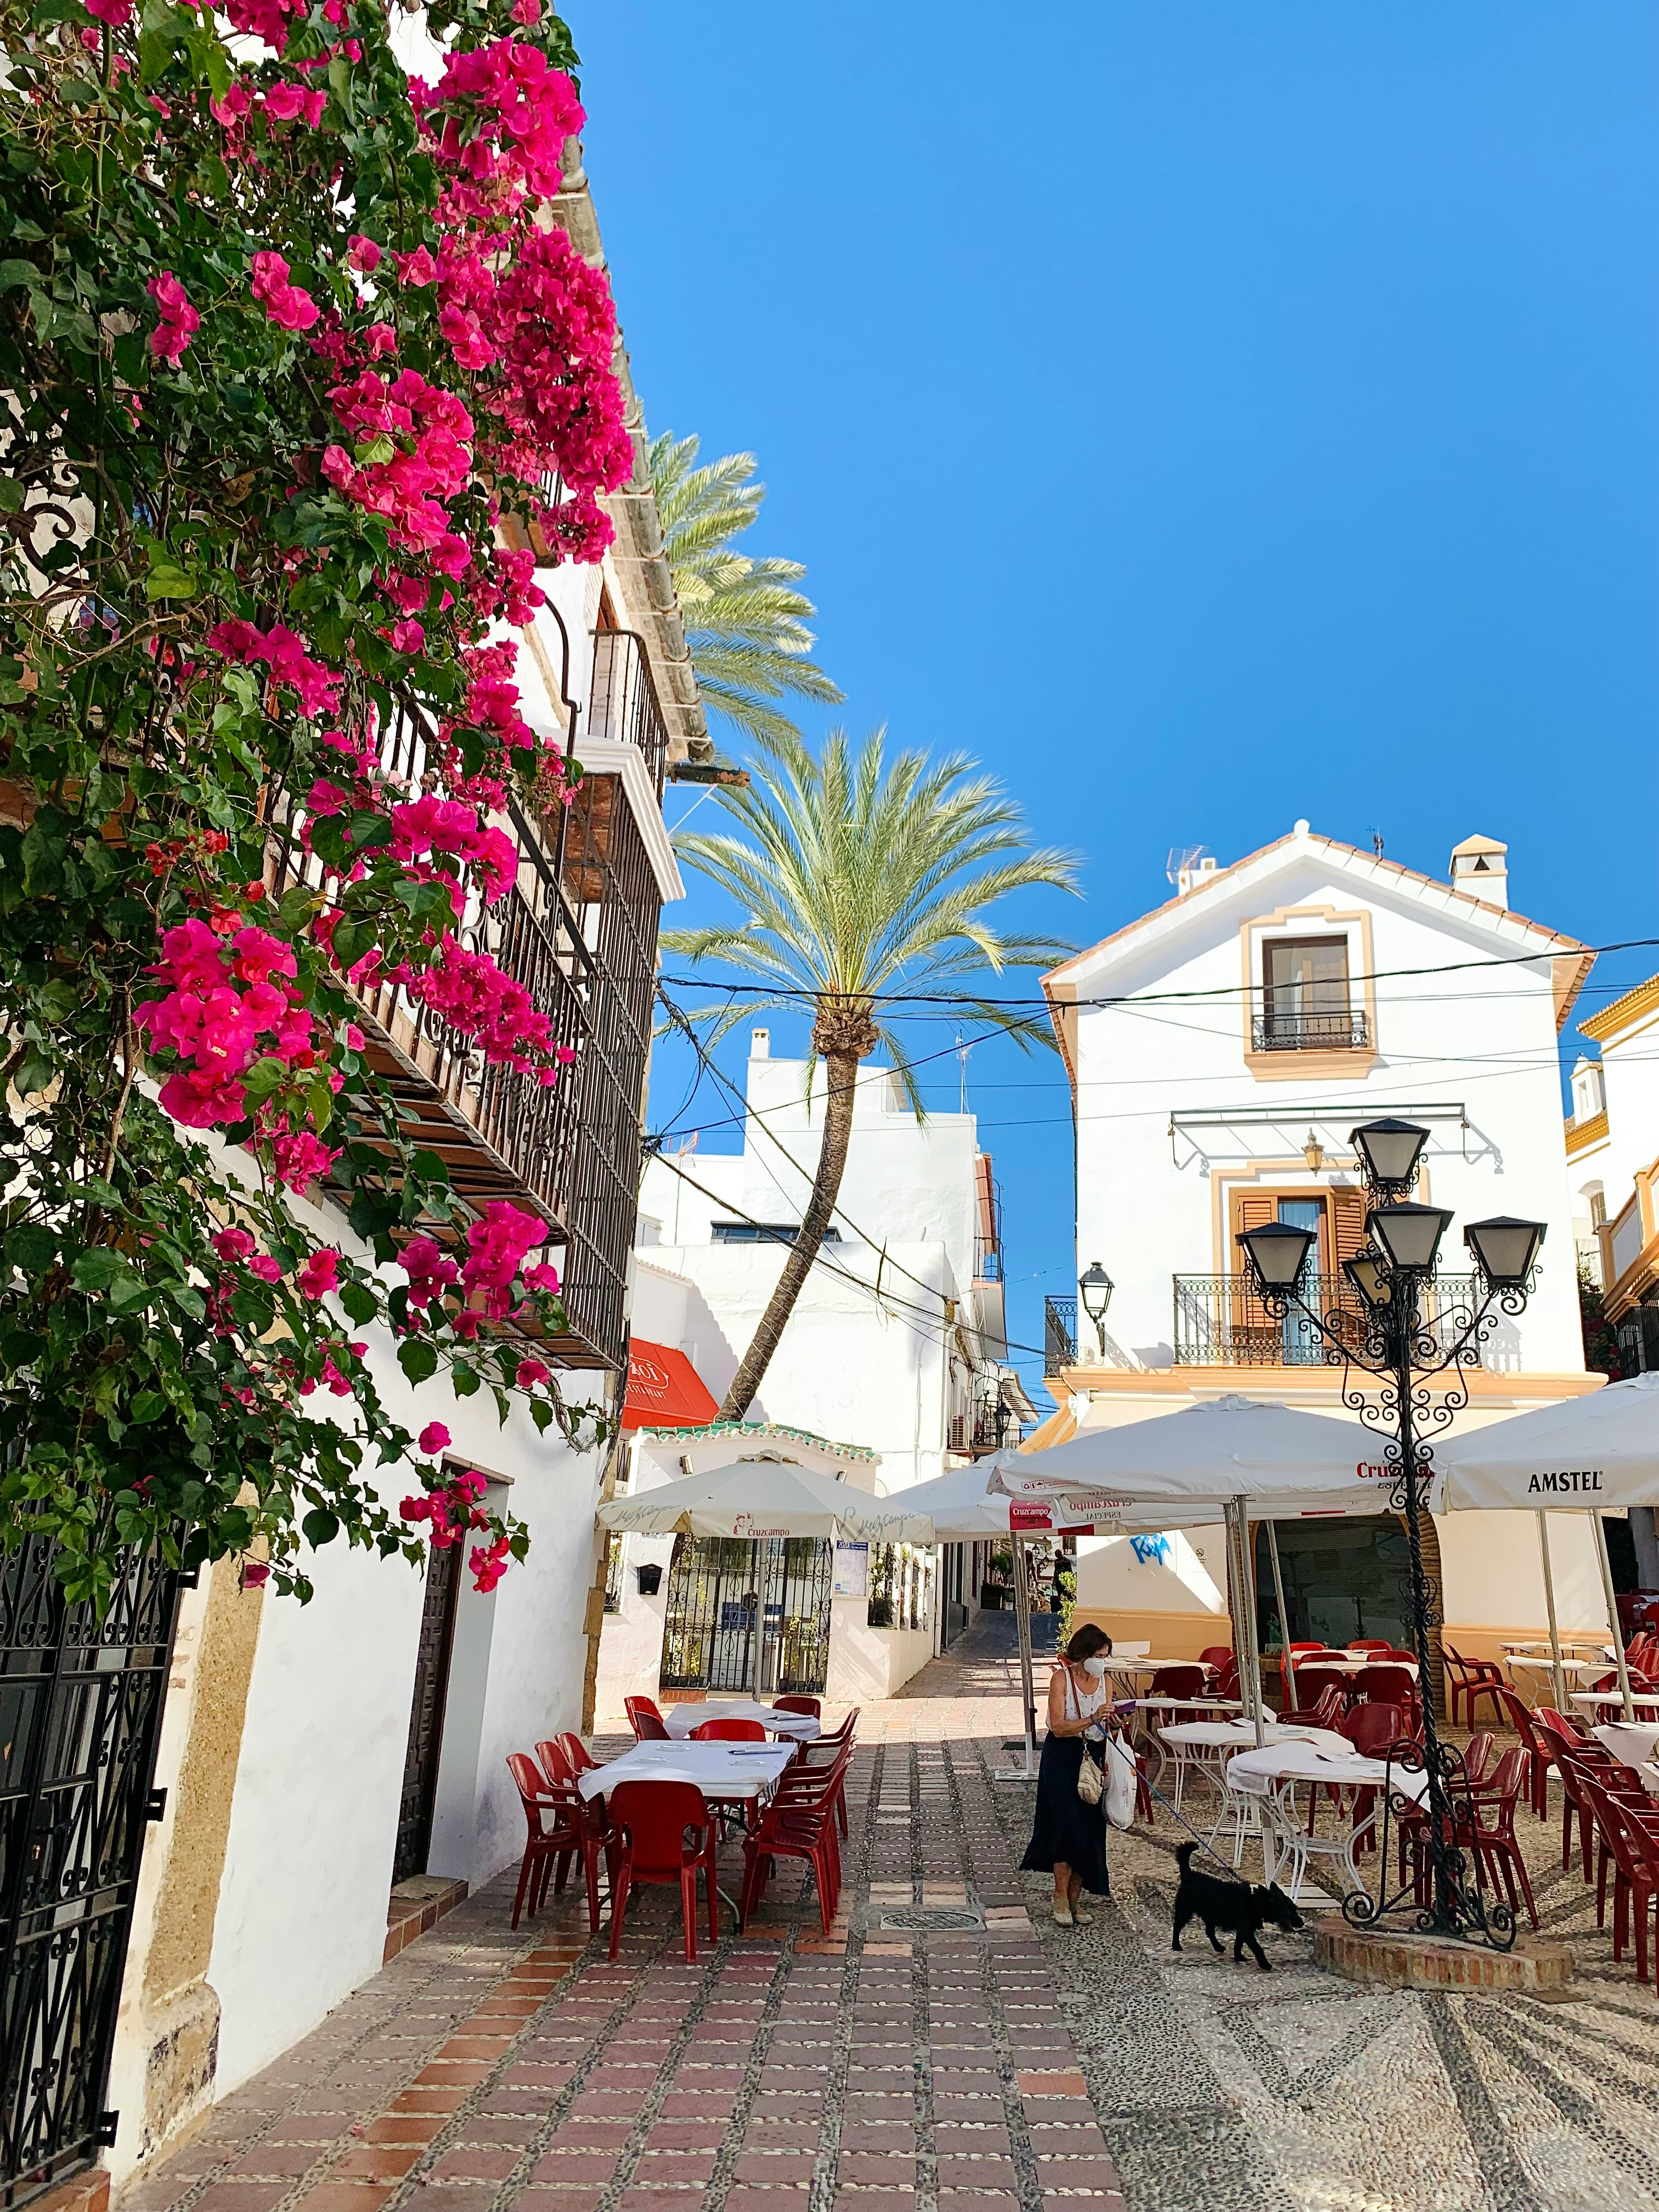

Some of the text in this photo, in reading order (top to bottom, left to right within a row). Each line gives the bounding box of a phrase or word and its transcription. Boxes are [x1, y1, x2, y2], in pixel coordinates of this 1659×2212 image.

[1527, 1471, 1603, 1493] AMSTEL
[1012, 1507, 1048, 1516] Cruzcampo
[747, 1528, 790, 1537] Cruzcampo
